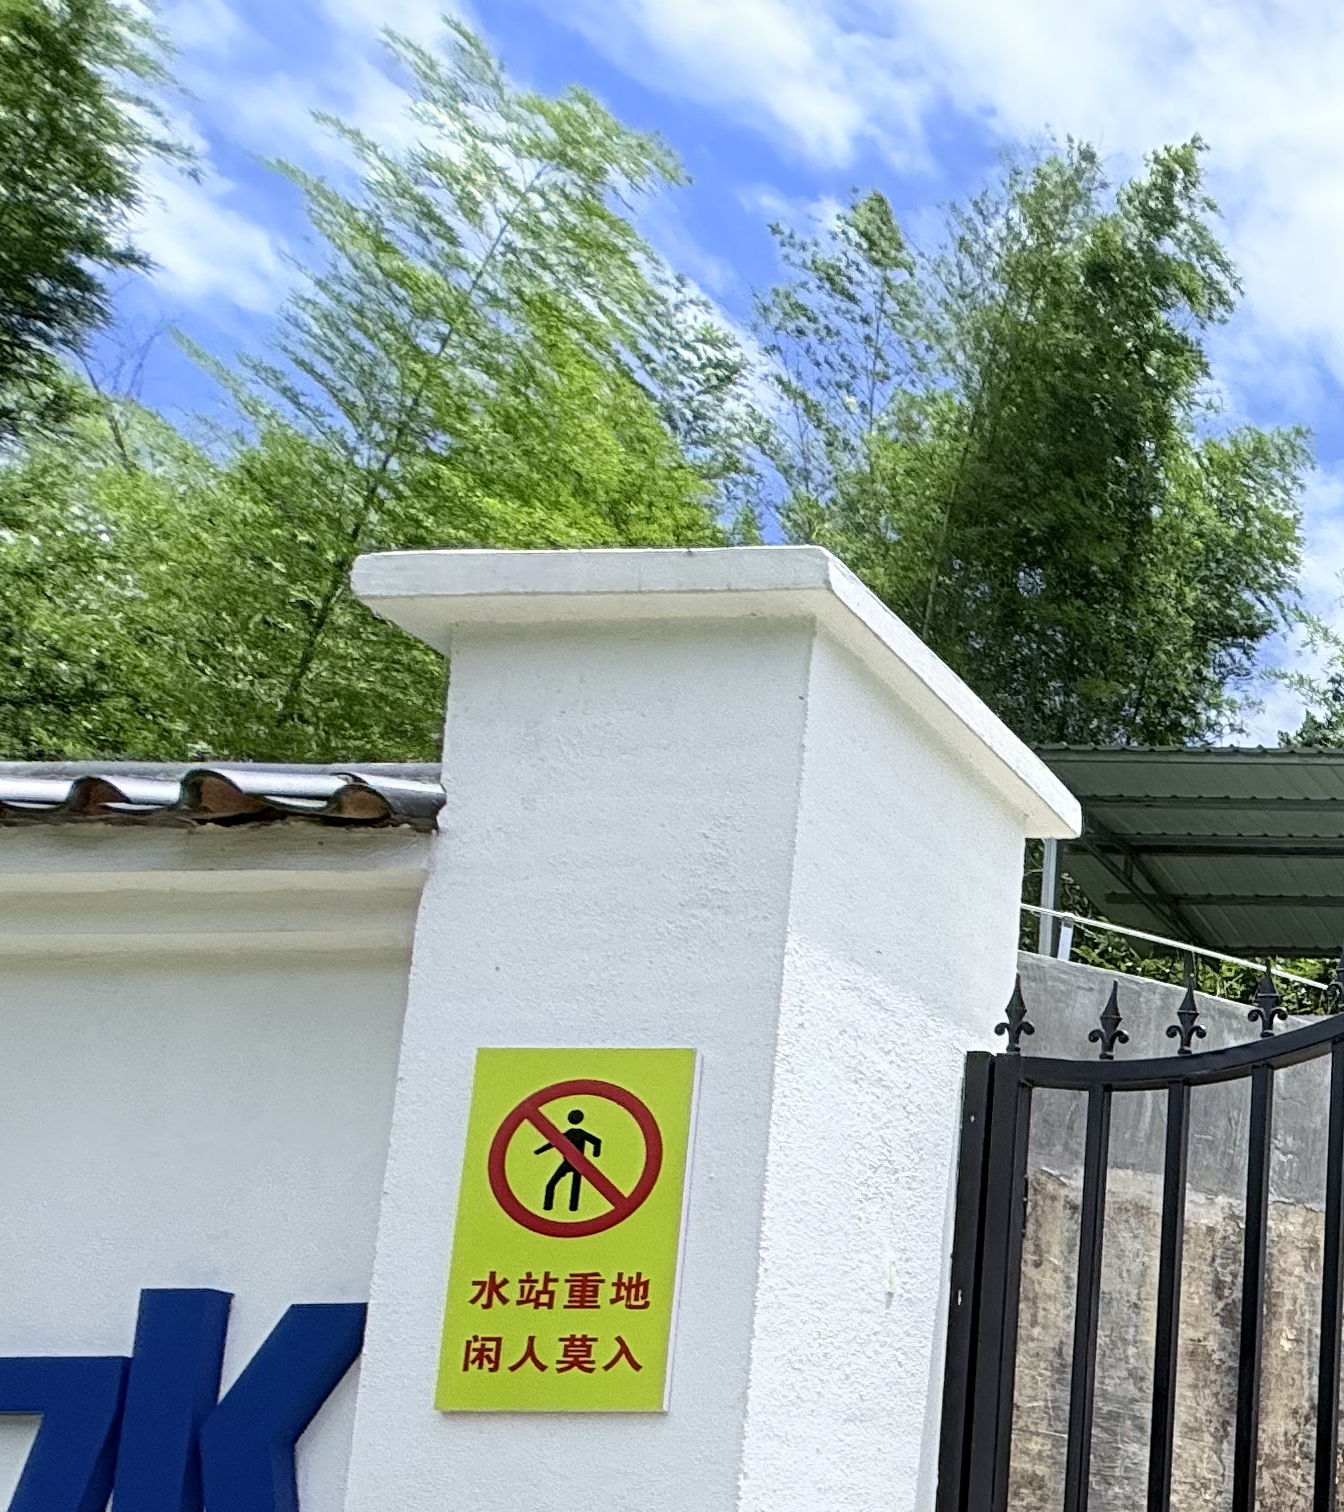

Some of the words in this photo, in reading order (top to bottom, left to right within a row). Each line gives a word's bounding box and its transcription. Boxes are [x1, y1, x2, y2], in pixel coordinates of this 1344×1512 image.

[468, 1270, 651, 1311] 水站重地
[462, 1334, 643, 1374] 闲人莫入
